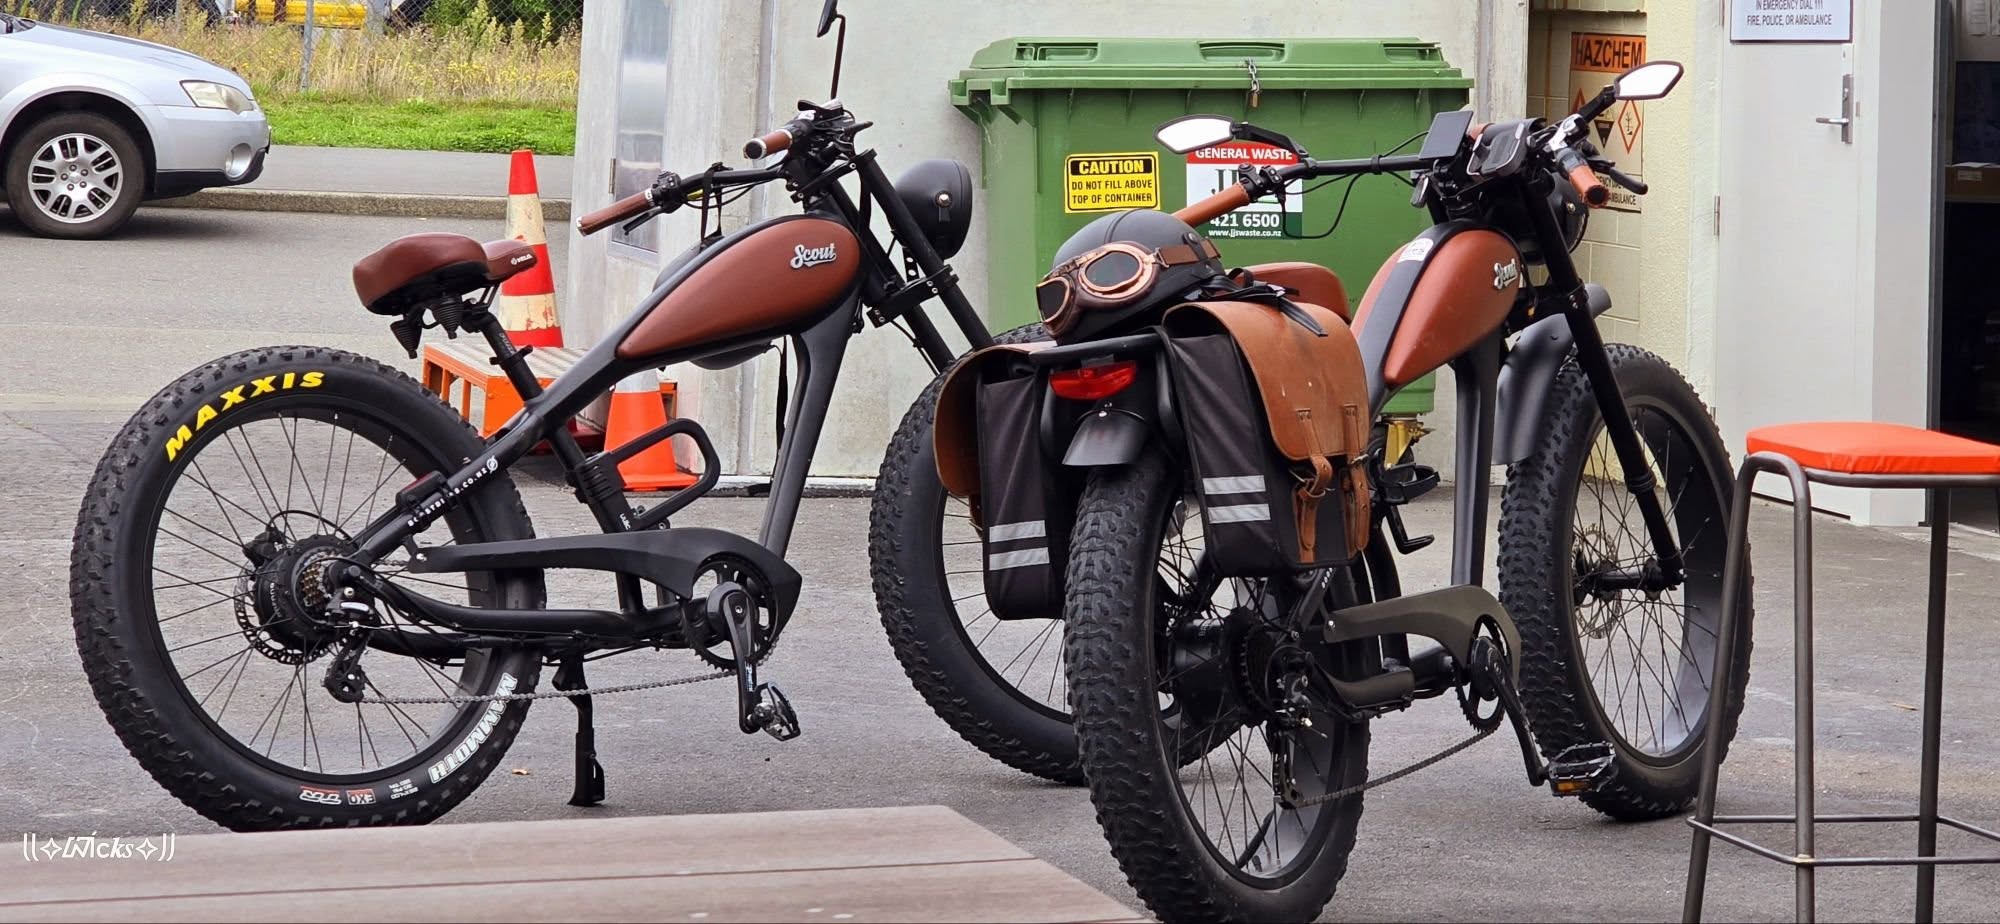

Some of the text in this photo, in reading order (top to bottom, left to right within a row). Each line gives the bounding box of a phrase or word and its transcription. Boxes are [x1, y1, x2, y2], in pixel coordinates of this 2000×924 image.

[1763, 0, 1799, 10] EMERGENCY
[1800, 0, 1813, 10] DIAL
[1814, 0, 1824, 9] 111
[1785, 14, 1795, 25] OR
[1795, 14, 1832, 25] AMBULANCE
[1575, 39, 1642, 69] HAZCHEM
[1195, 147, 1293, 160] GENERAL WASTE
[1079, 160, 1144, 174] CAUTION
[1072, 180, 1152, 190] DO NOT FILL ABOVE
[1072, 193, 1152, 204] TOP OF CONTAINER
[1210, 213, 1280, 228] 421 6500
[1208, 229, 1281, 238] www.jjswaste.co.nz
[790, 243, 837, 269] Scout
[165, 372, 325, 462] MAXXIS
[428, 672, 518, 783] MAMMOTH
[348, 793, 375, 805] EXO
